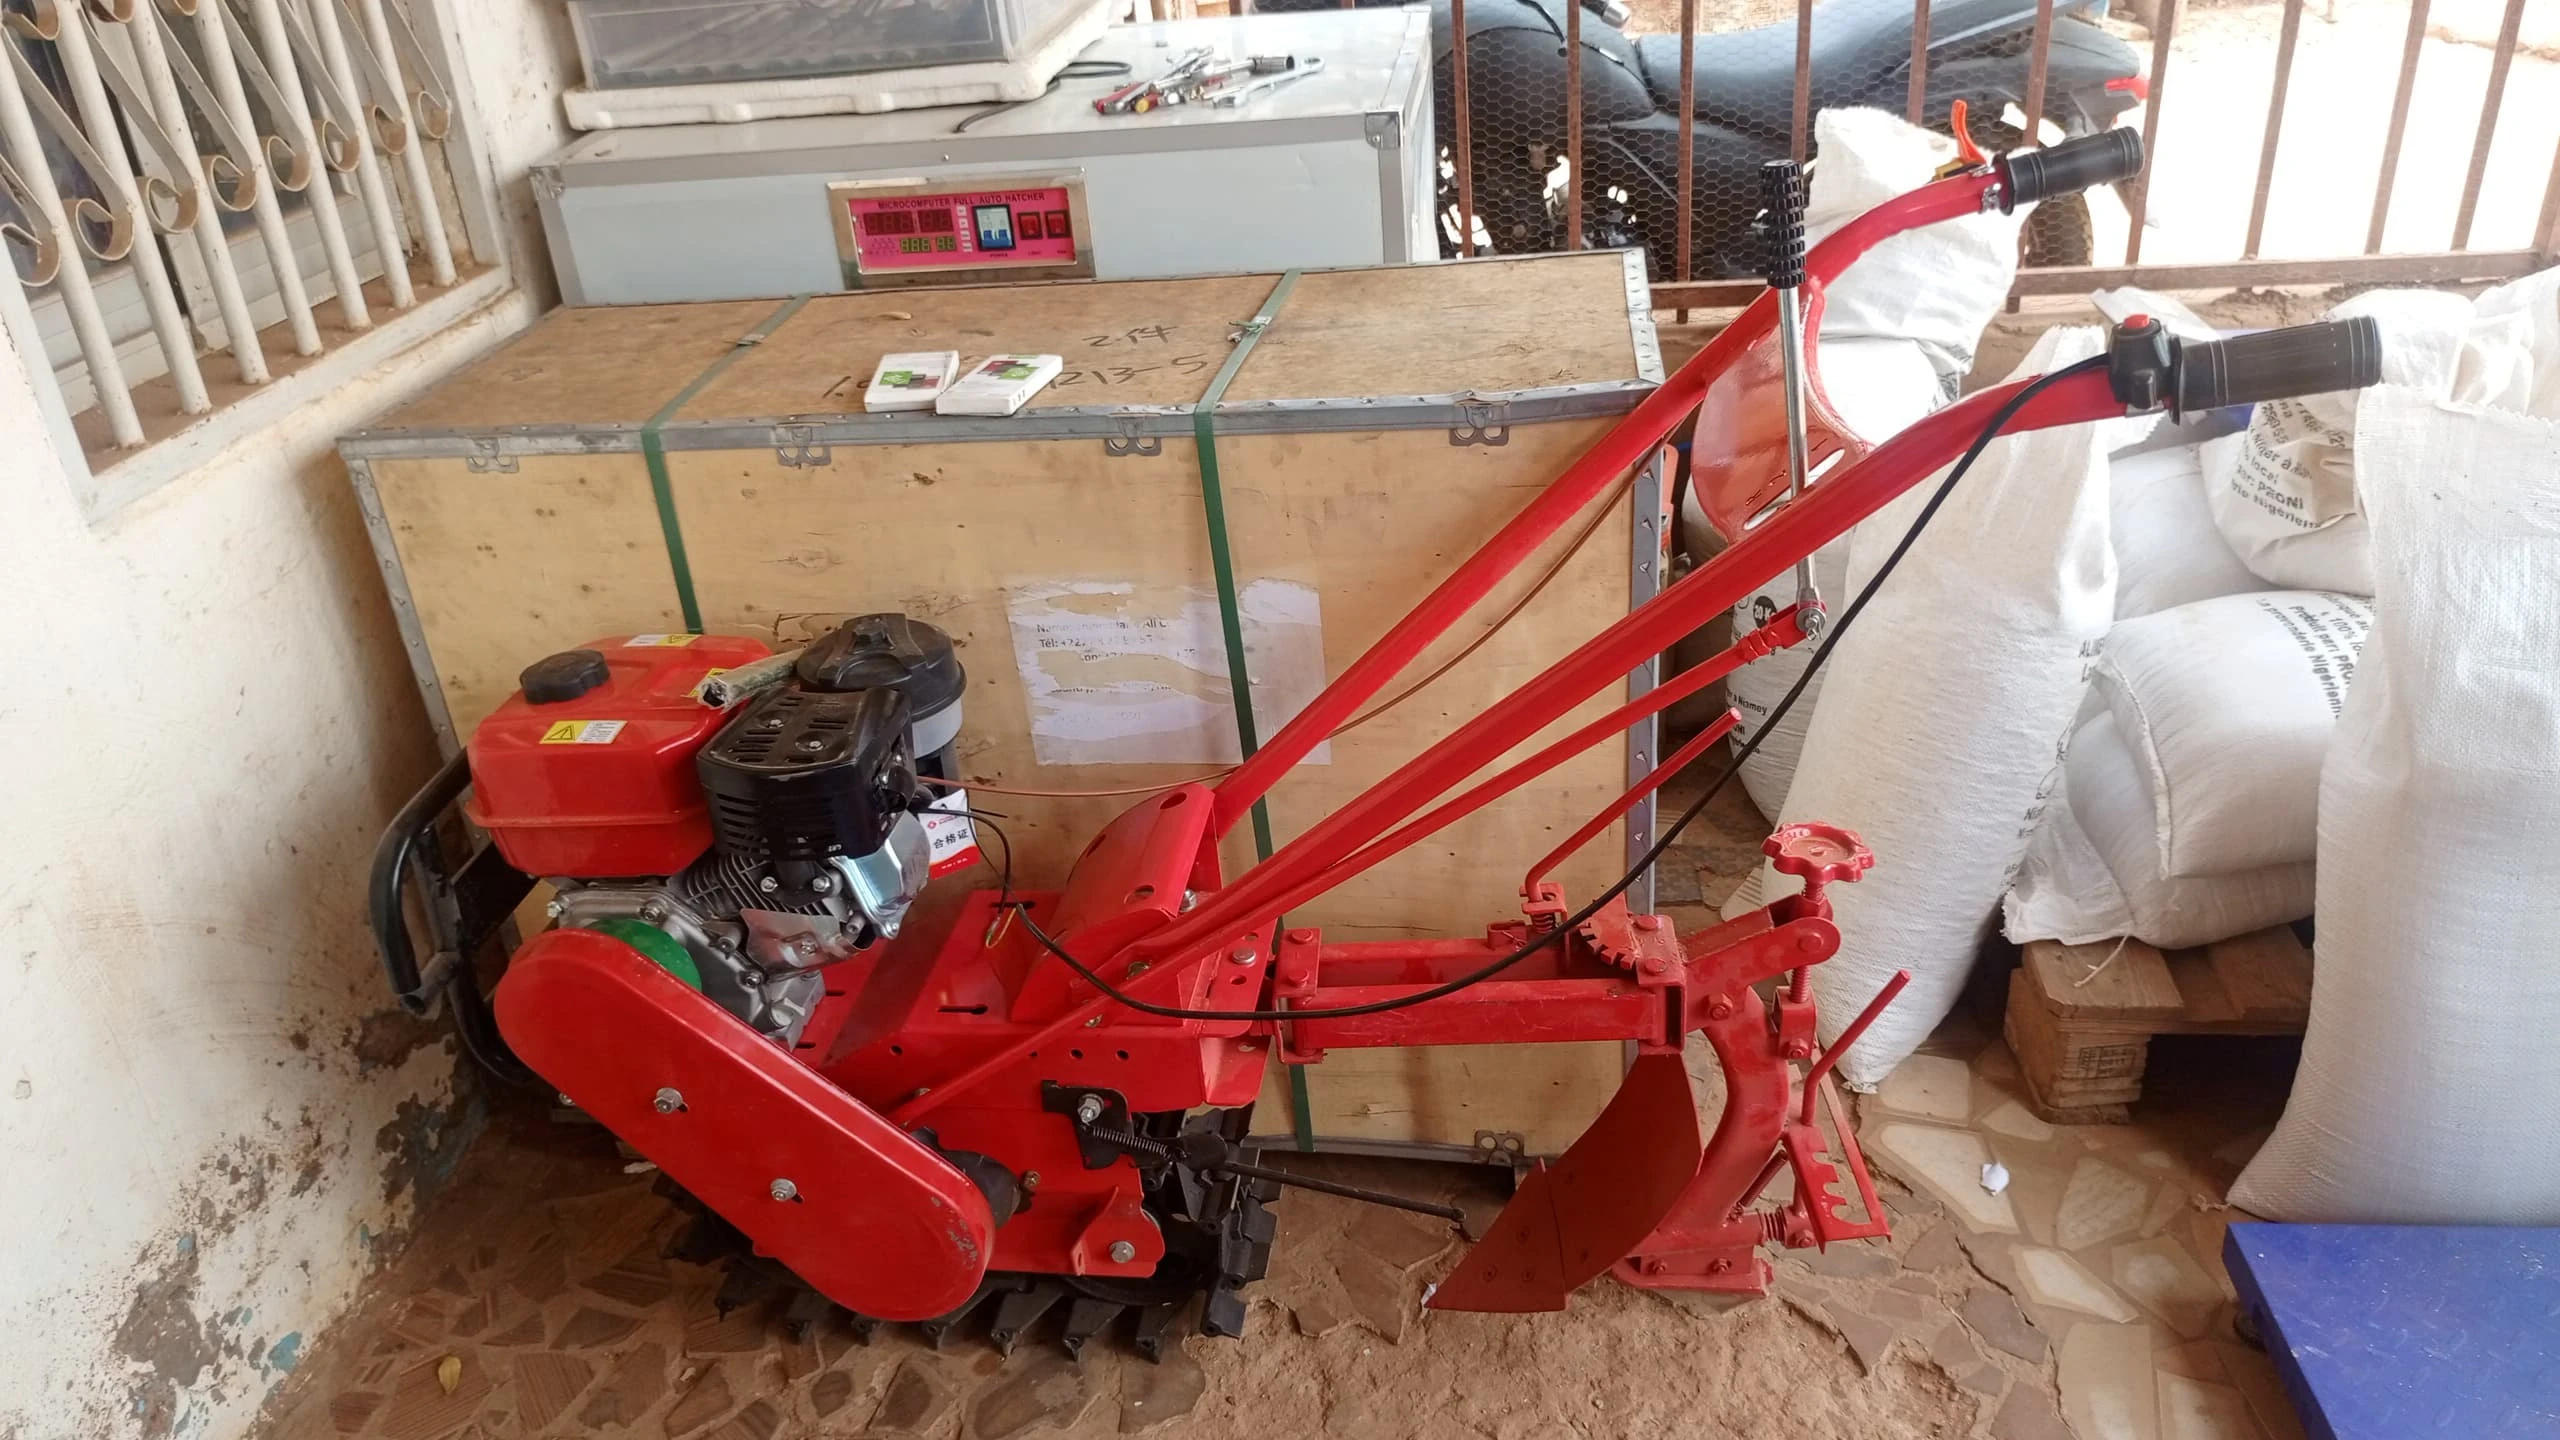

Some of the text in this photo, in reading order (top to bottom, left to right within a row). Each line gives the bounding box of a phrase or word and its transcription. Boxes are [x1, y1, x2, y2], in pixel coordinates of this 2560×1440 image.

[878, 192, 1045, 210] MICROCOMPUTER FULL AUTO HATCHER
[1738, 695, 1768, 716] Niamey
[933, 828, 970, 849] 合格证
